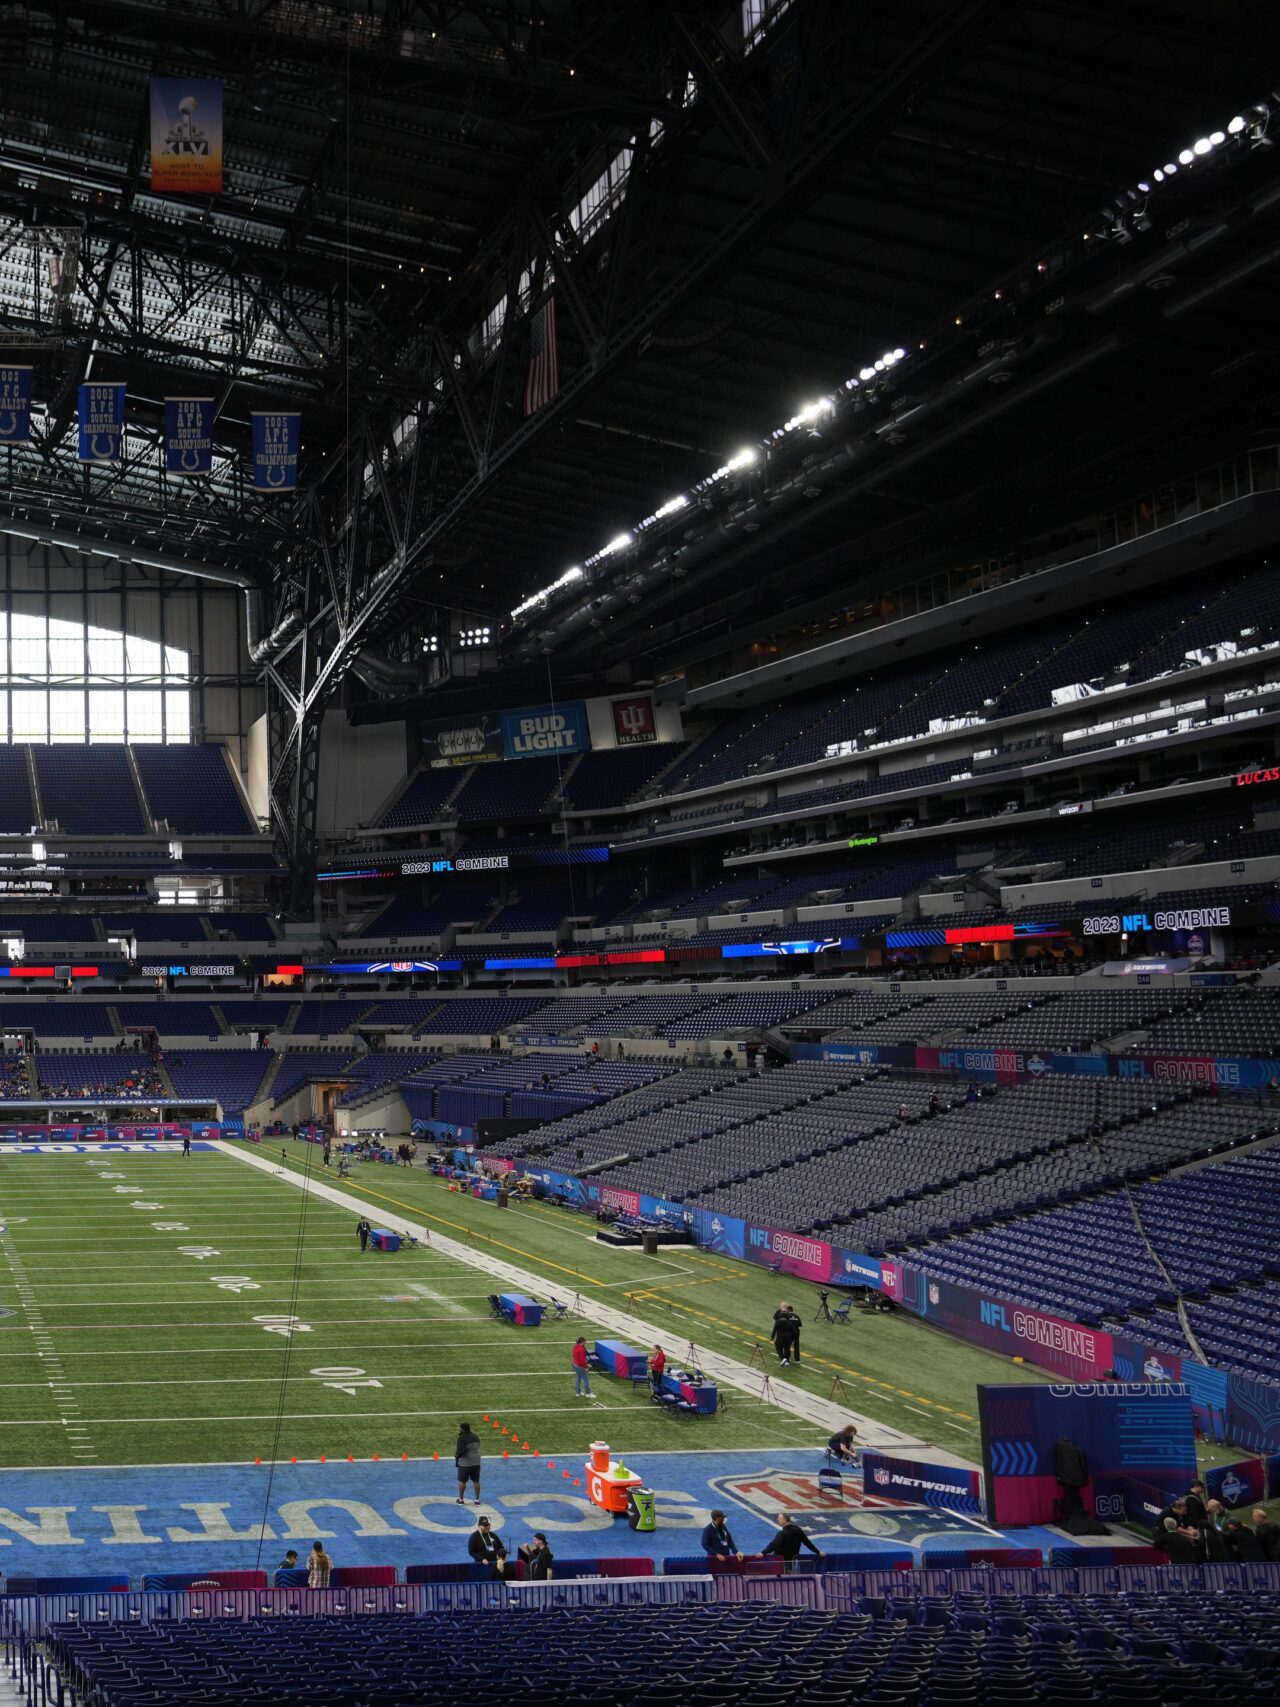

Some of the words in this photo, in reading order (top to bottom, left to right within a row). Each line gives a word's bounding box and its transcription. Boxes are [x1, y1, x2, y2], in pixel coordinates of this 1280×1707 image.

[90, 401, 114, 413] AFC
[90, 413, 114, 424] SOUTH
[177, 413, 203, 427] AFC
[265, 417, 288, 428] 2005
[83, 424, 120, 434] CHAMPIONS
[178, 428, 202, 439] SOUTH
[264, 428, 289, 443] AFC
[169, 438, 211, 450] CHAMPIONS
[265, 443, 289, 454] SOUTH
[256, 454, 297, 466] CHAMPIONS
[520, 715, 565, 735] BUD
[513, 730, 576, 752] LIGHT
[620, 733, 655, 743] HEALTH
[1236, 767, 1280, 786] LUCAS
[1058, 806, 1080, 815] verizon
[402, 863, 430, 875] 2023
[433, 860, 454, 872] NFL
[456, 856, 508, 871] COMBINE
[1083, 915, 1119, 935] 2023
[1122, 913, 1152, 932] NFL
[1154, 907, 1230, 930] COMBINE
[142, 966, 168, 976] 2023
[170, 966, 188, 975] NFL
[190, 966, 235, 976] COMBINE
[938, 1052, 962, 1068] NFL
[964, 1053, 1024, 1072] COMBINE
[1118, 1059, 1151, 1078] NFL
[1153, 1060, 1240, 1084] COMBINE
[749, 1227, 771, 1250] NFL
[772, 1234, 822, 1266] COMBINE
[852, 1263, 879, 1280] NETWORK
[210, 1275, 262, 1290] 30
[252, 1315, 315, 1333] 20
[979, 1300, 1011, 1333] NFL
[1013, 1311, 1095, 1362] COMBINE
[310, 1367, 384, 1390] 10
[592, 1476, 603, 1503] G
[875, 1474, 889, 1484] NFL
[891, 1474, 969, 1496] NETWORK
